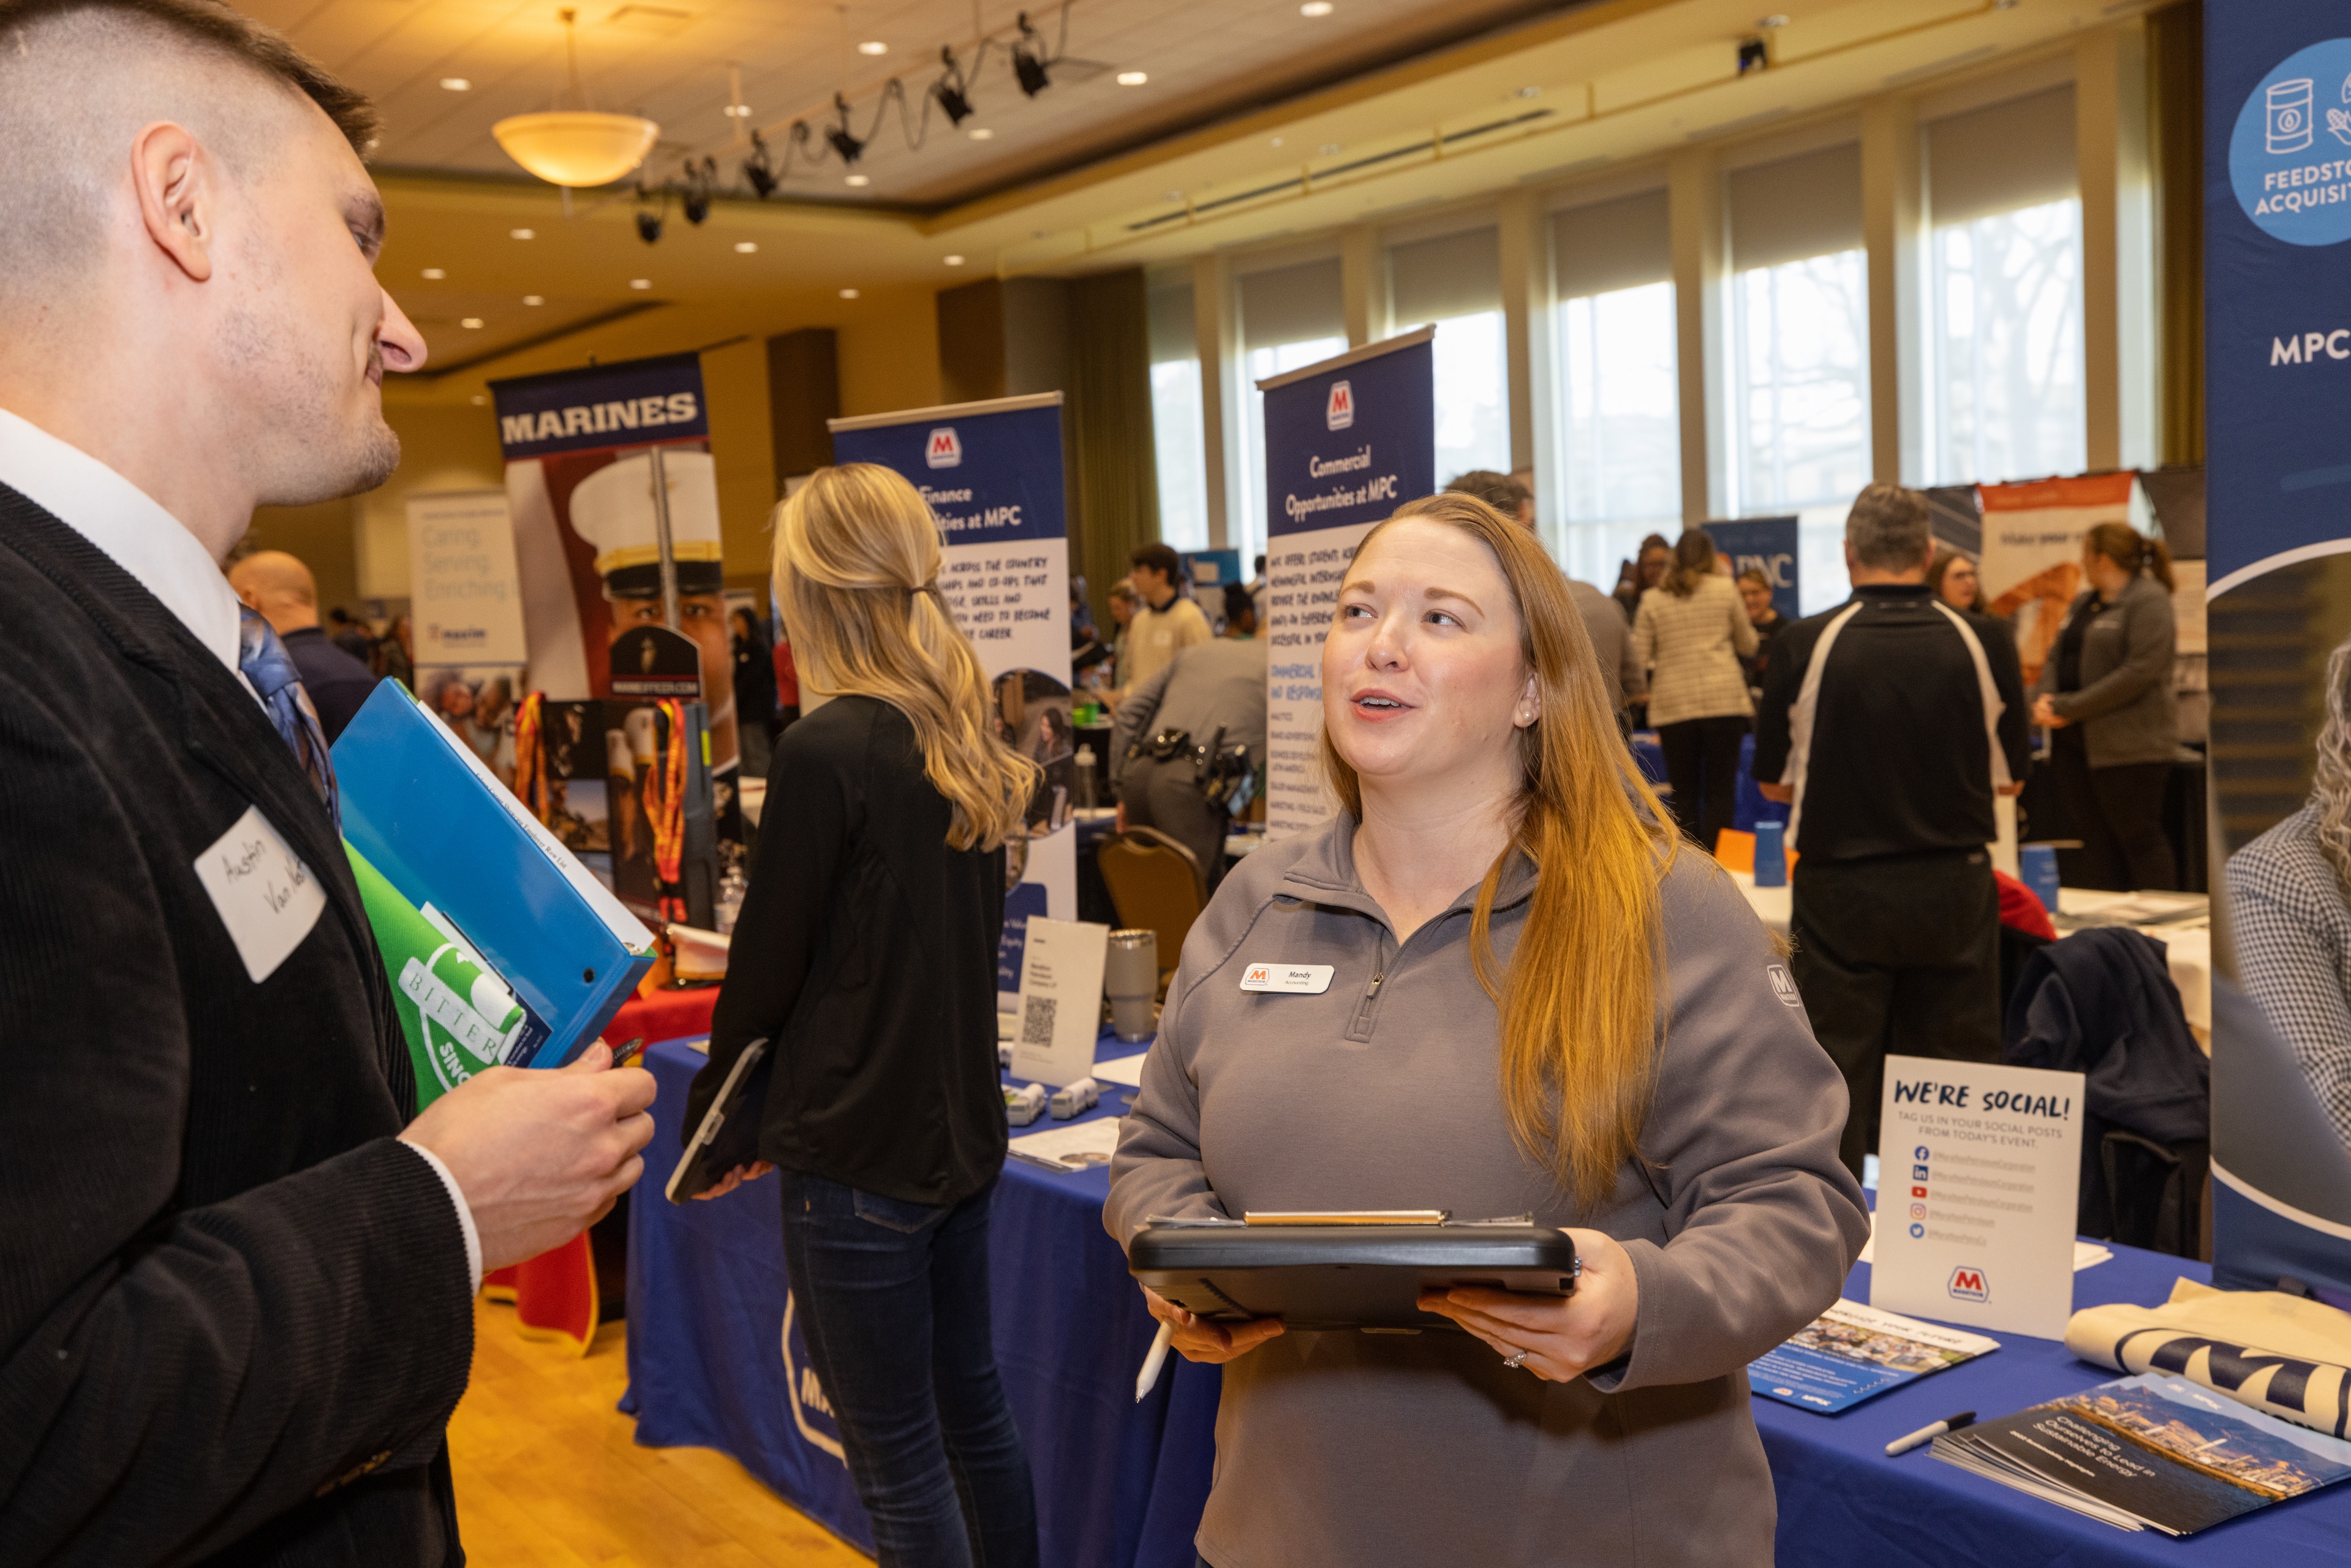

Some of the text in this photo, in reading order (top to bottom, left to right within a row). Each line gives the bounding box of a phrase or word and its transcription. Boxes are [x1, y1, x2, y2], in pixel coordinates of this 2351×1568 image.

[2270, 329, 2351, 367] MPC
[502, 391, 699, 445] MARINES
[1310, 443, 1372, 478] Commercial
[919, 485, 973, 505] Finance
[1286, 475, 1398, 522] Opportunities at MPC
[967, 512, 983, 529] at
[984, 505, 1022, 529] MPC
[985, 558, 1001, 572] THE
[1005, 556, 1048, 571] COUNTRY
[1014, 608, 1051, 623] BECOME
[543, 845, 558, 860] Row
[555, 856, 568, 870] List
[1250, 970, 1266, 979] M
[1288, 971, 1311, 980] Mandy
[1770, 970, 1792, 993] M
[409, 973, 496, 1057] BITTER
[1894, 1080, 2070, 1121] WE'RE SOCIAL!
[1898, 1110, 2062, 1139] TAG US IN YOUR SOCIAL POSTS
[1919, 1126, 1950, 1138] FROM
[1953, 1130, 1998, 1144] TODAY'S
[1955, 1271, 1982, 1291] M
[2056, 1415, 2122, 1452] Challenging
[2032, 1422, 2138, 1477] Sustainable Energy
[2044, 1419, 2156, 1477] Ourselves to Lead in
